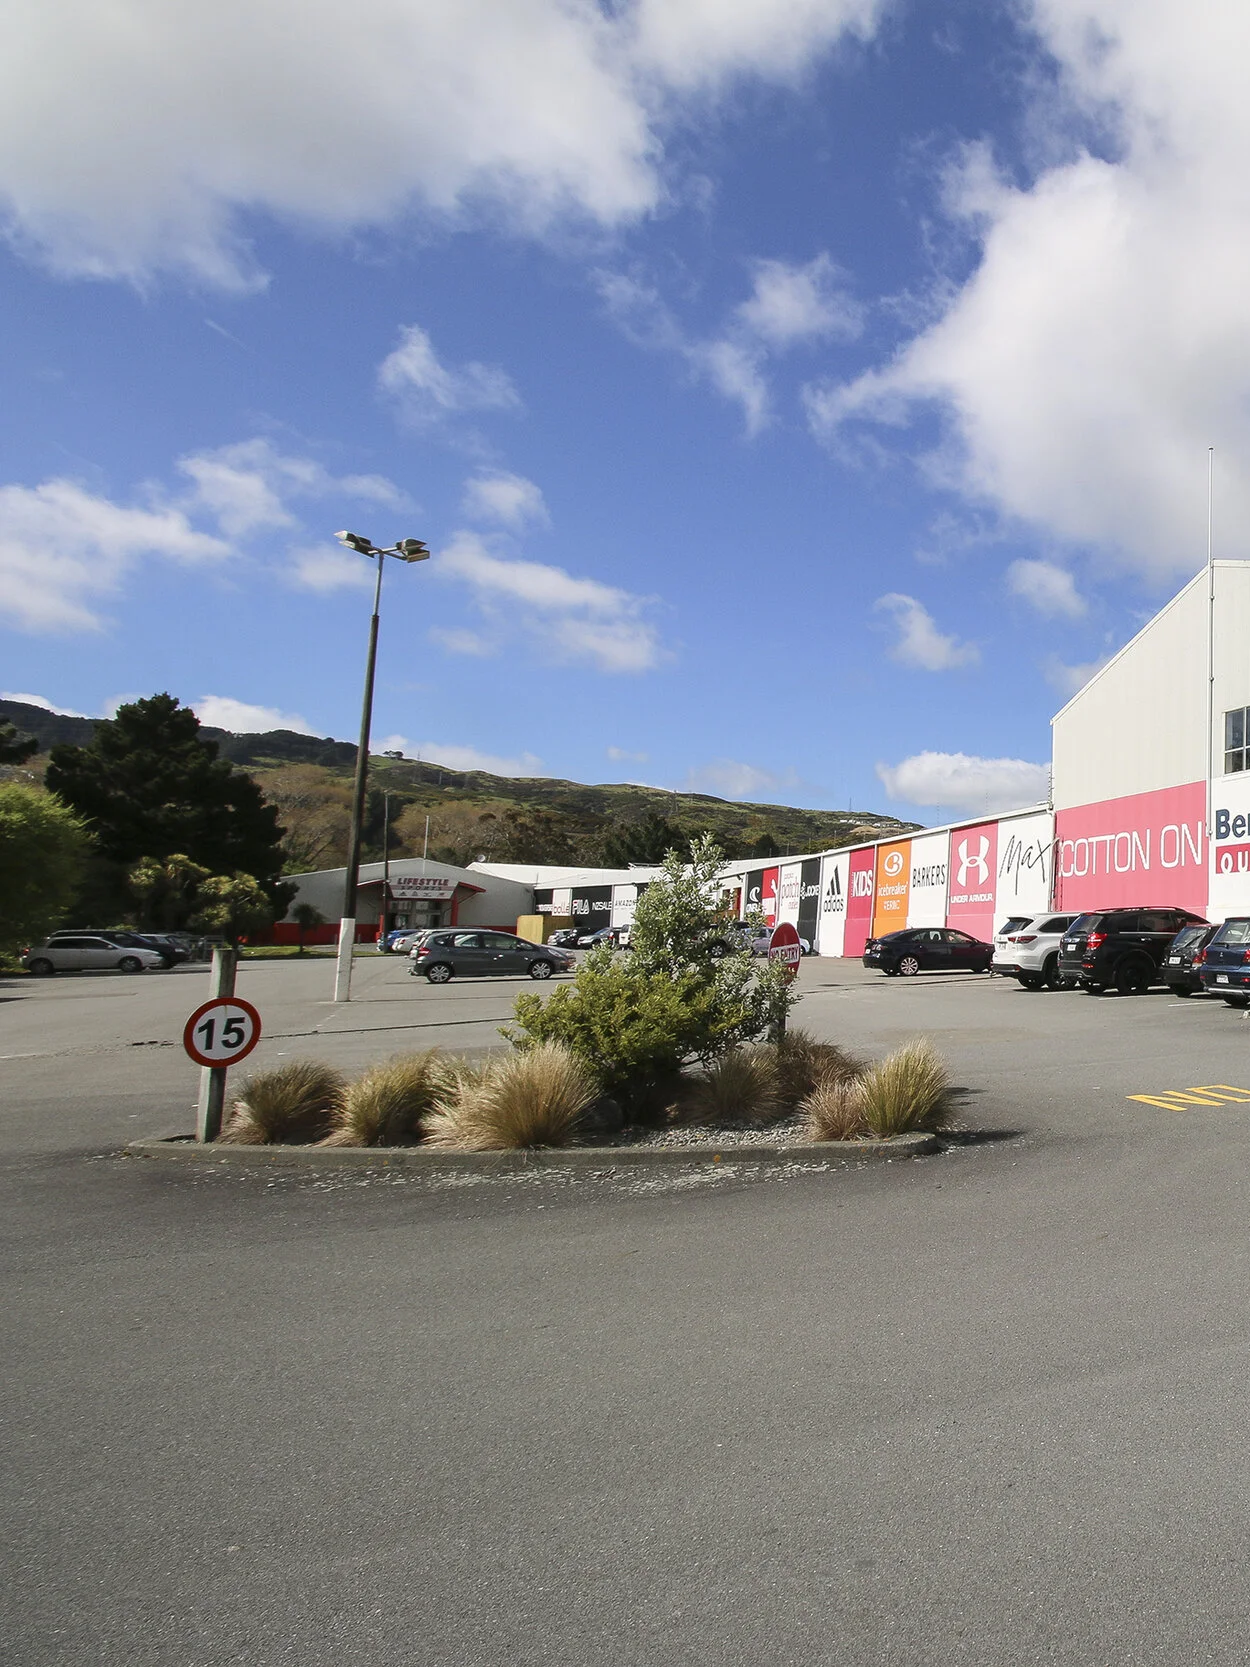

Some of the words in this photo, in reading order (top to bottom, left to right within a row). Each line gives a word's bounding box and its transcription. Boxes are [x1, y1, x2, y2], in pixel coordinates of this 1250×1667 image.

[1060, 828, 1151, 878] COTTON
[1160, 822, 1203, 868] ON
[397, 877, 449, 886] LIFESTYLE
[852, 869, 873, 898] KIDS
[912, 864, 946, 889] BARKERS
[878, 881, 908, 897] icebreaker
[950, 893, 968, 904] UNDER
[969, 892, 994, 903] ARMOUR
[572, 899, 590, 915] FILA
[823, 895, 844, 913] adidas
[197, 1016, 246, 1051] 15
